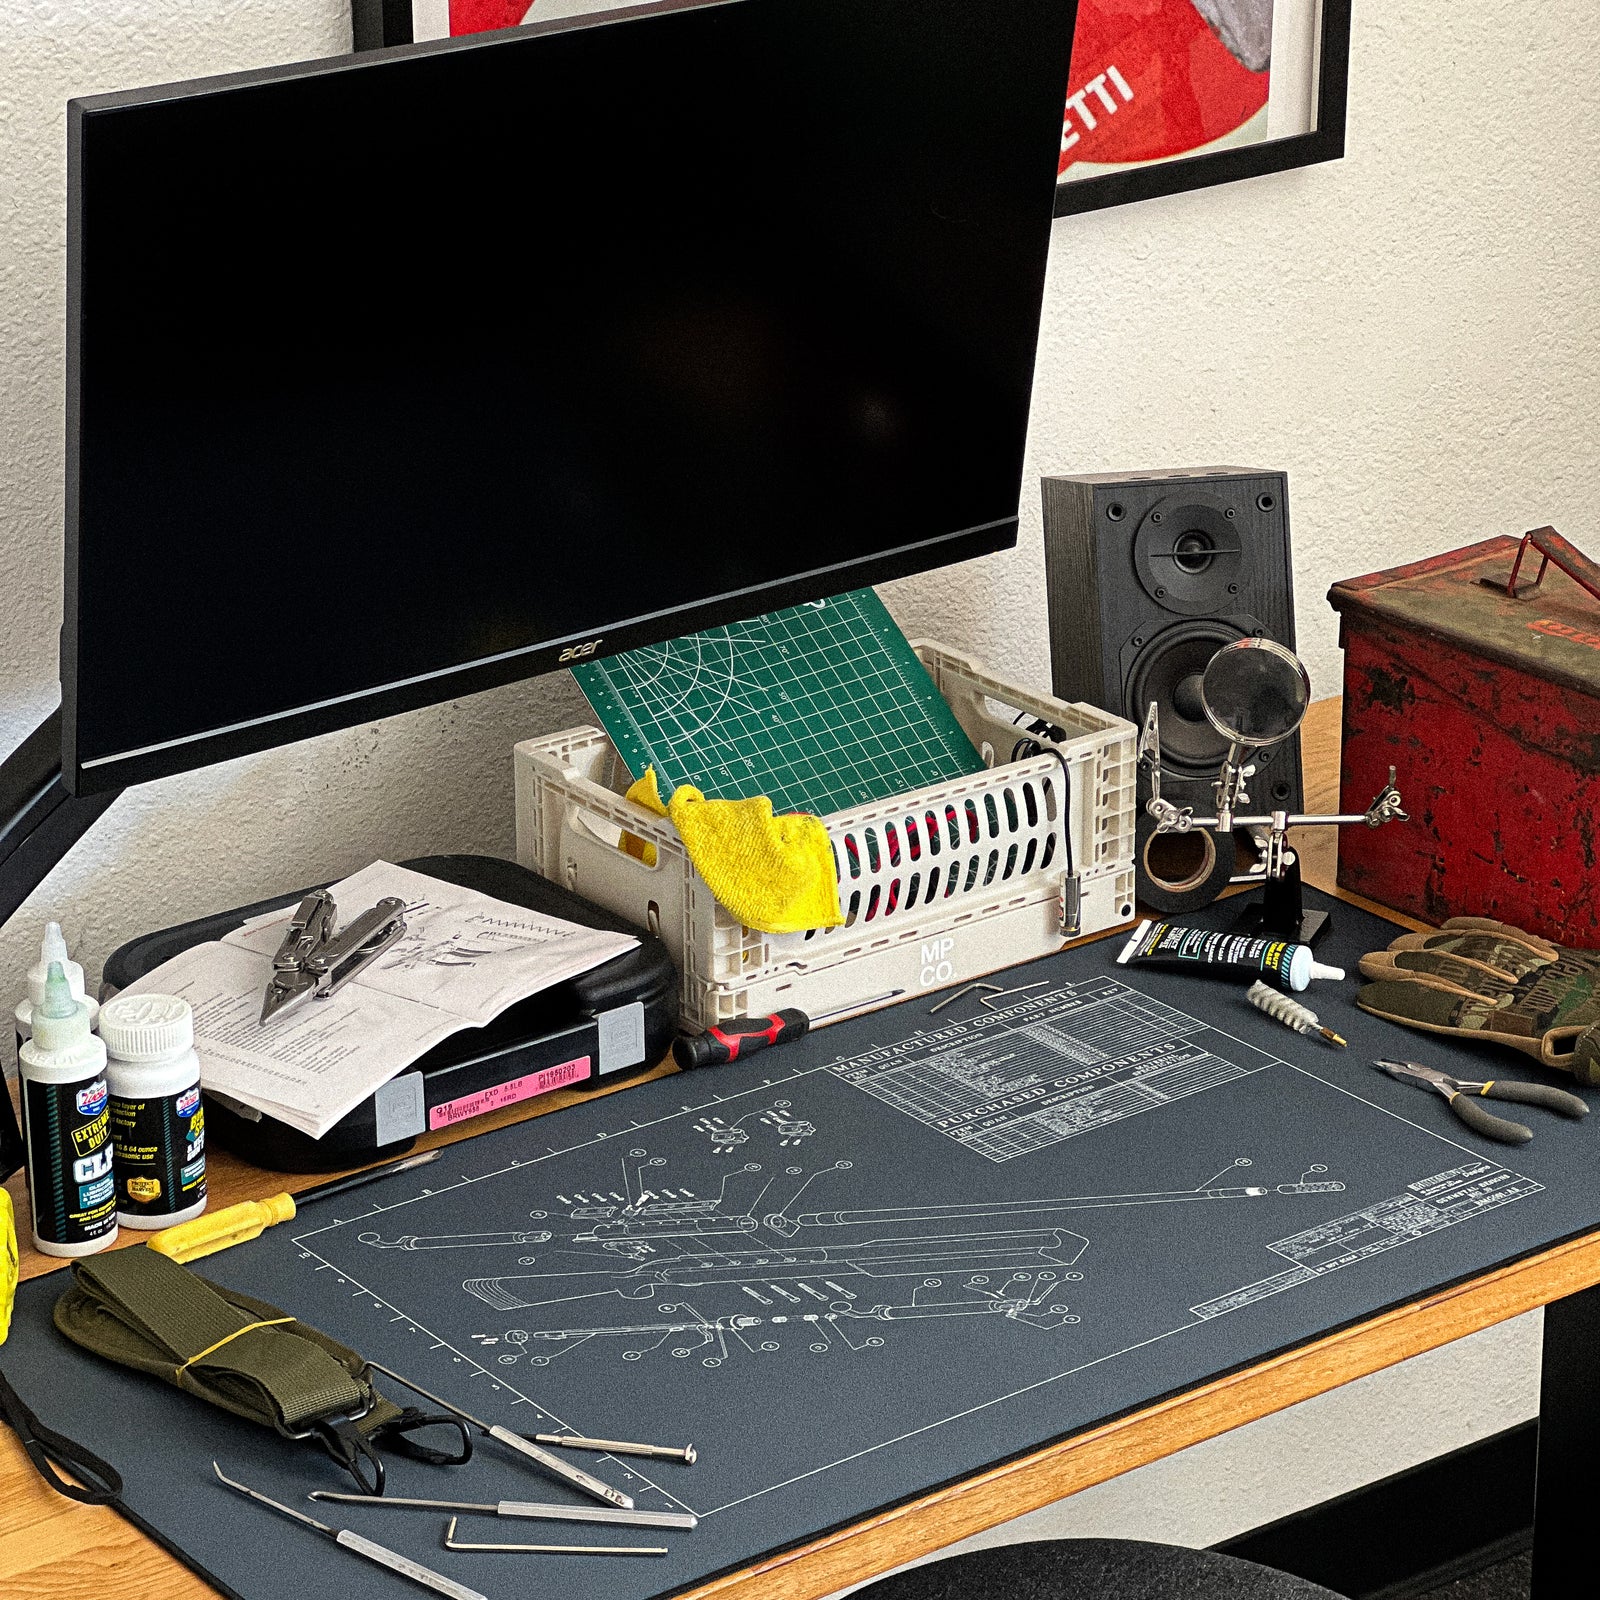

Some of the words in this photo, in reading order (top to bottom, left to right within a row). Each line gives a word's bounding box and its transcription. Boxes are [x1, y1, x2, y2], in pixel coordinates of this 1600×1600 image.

[559, 639, 603, 662] acer
[921, 937, 955, 965] MP
[831, 1025, 968, 1073] MANUFACTURED
[973, 989, 1078, 1027] COMPONENTS
[936, 1087, 1046, 1128] PURCHASED
[1054, 1043, 1176, 1088] COMPONENTS
[74, 1109, 110, 1143] EXTREME
[88, 1125, 107, 1149] DUTY
